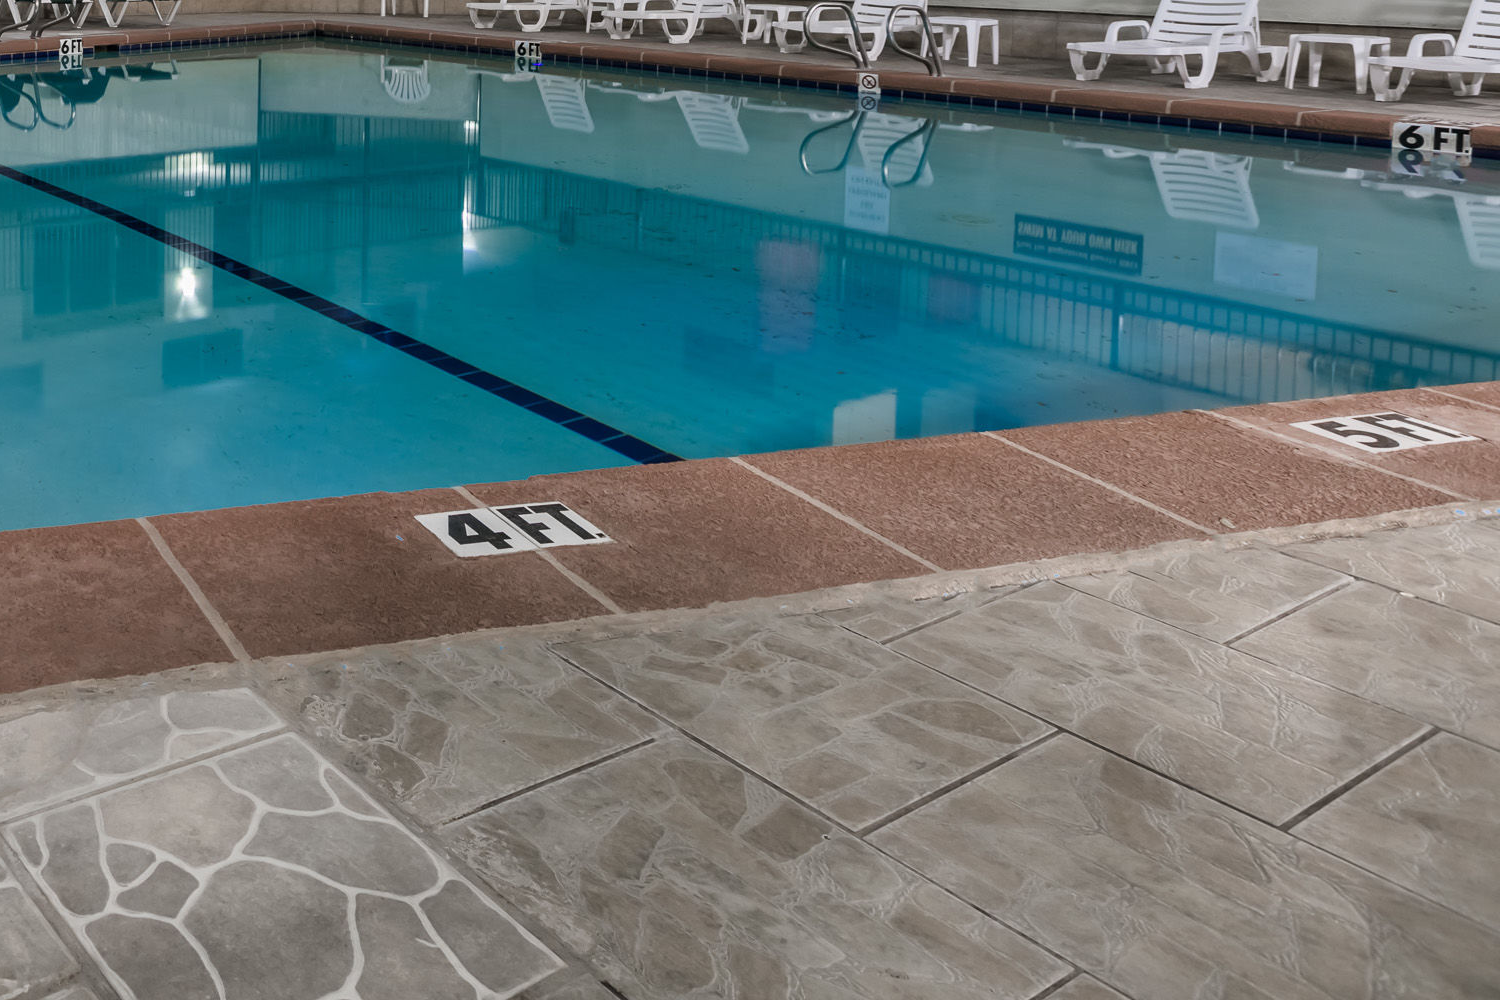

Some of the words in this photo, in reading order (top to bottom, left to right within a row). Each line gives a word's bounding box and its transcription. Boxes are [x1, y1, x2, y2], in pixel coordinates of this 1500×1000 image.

[61, 40, 70, 55] 6
[517, 42, 527, 56] 6
[1399, 125, 1425, 149] 6
[1433, 127, 1471, 153] FT.
[1311, 421, 1400, 449] 5
[448, 513, 513, 550] 4
[496, 503, 606, 545] FT.
